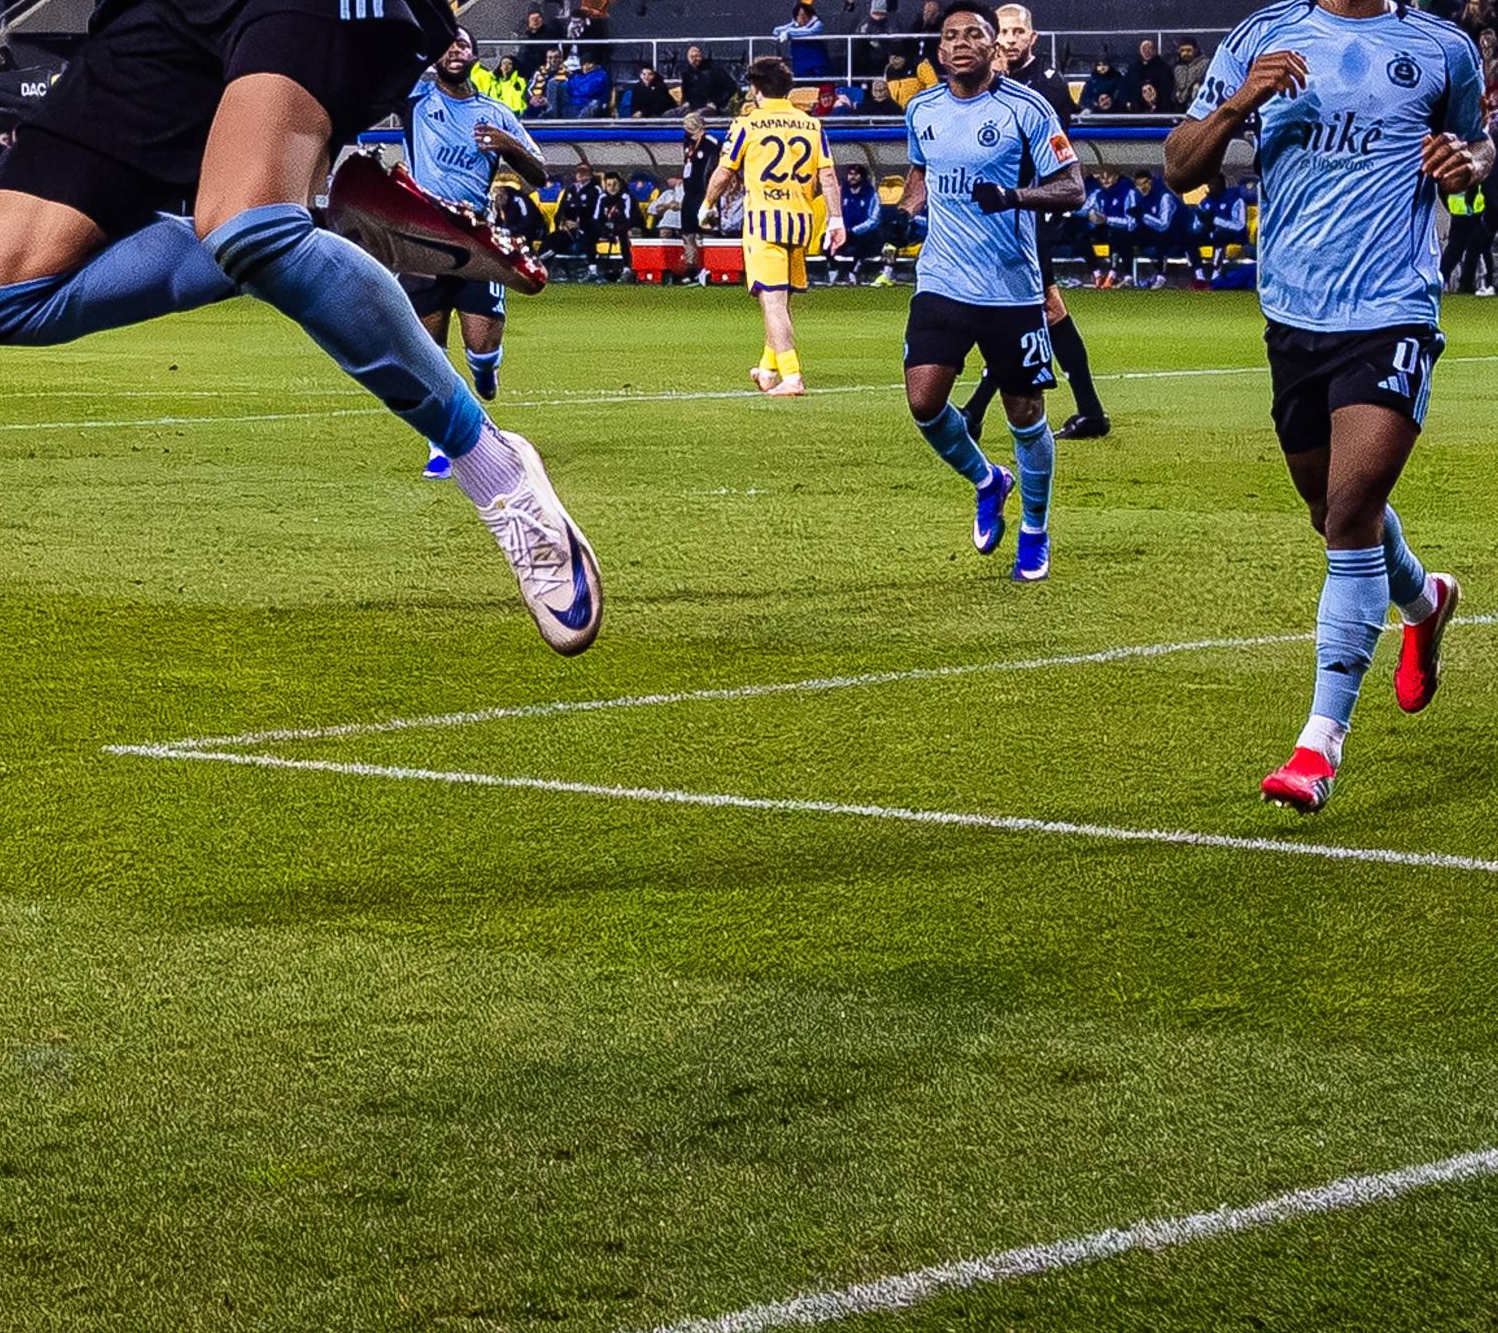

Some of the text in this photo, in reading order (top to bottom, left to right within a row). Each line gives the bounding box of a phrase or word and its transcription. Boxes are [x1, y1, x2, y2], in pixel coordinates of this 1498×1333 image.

[20, 82, 48, 98] DAC
[760, 135, 813, 184] 22
[1020, 327, 1051, 367] 28
